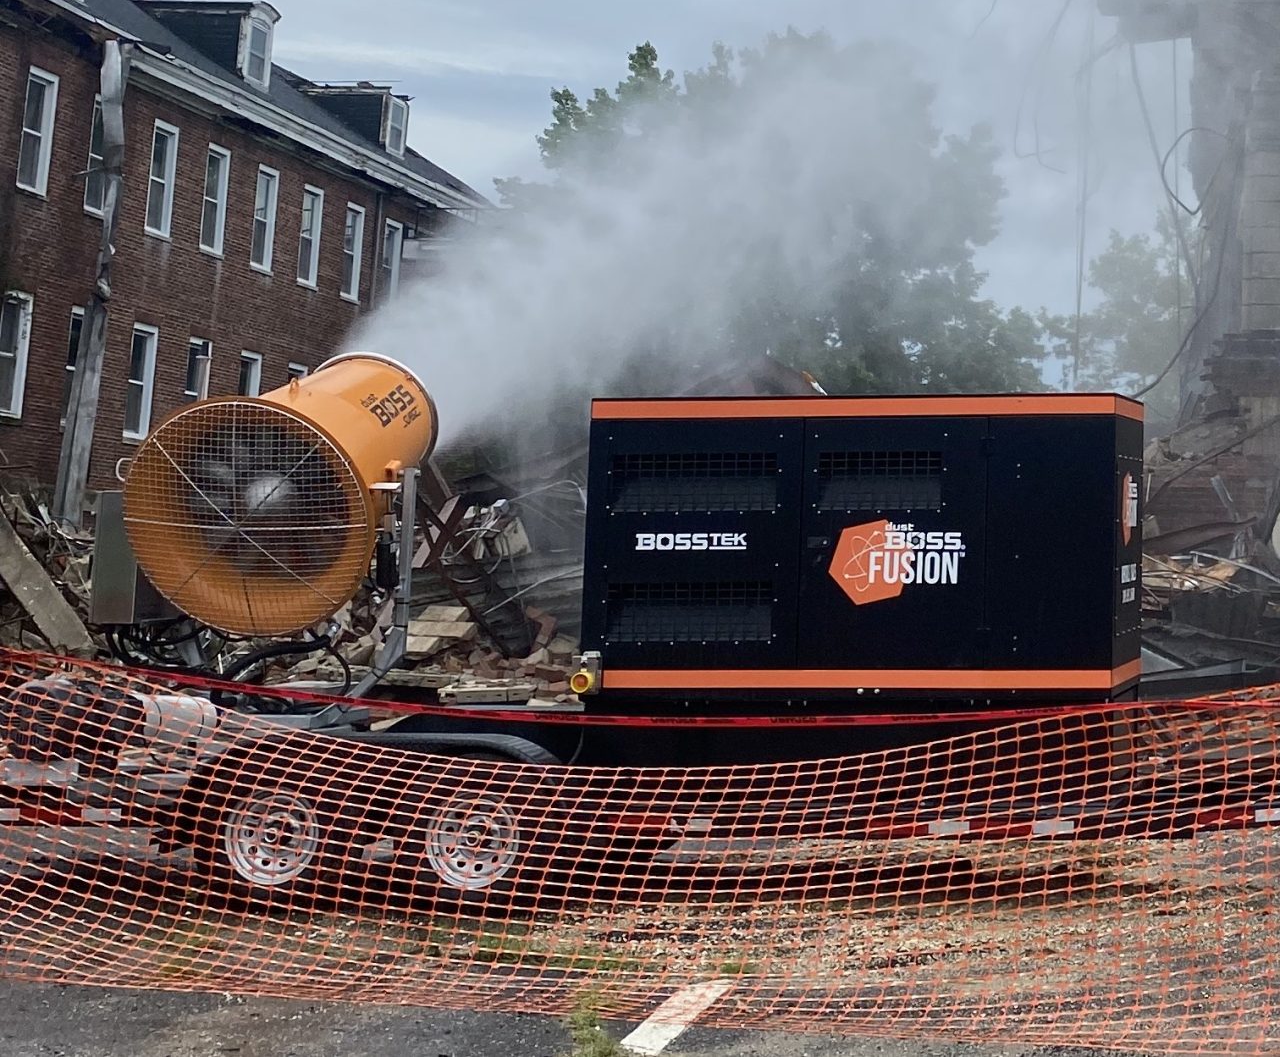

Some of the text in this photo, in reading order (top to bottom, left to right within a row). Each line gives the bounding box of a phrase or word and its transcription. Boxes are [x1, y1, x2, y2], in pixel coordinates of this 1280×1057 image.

[369, 384, 415, 428] BOSS
[885, 522, 914, 531] dust
[635, 533, 747, 550] BOSSTEK
[884, 532, 962, 550] BOSS
[868, 551, 959, 584] FUSION
